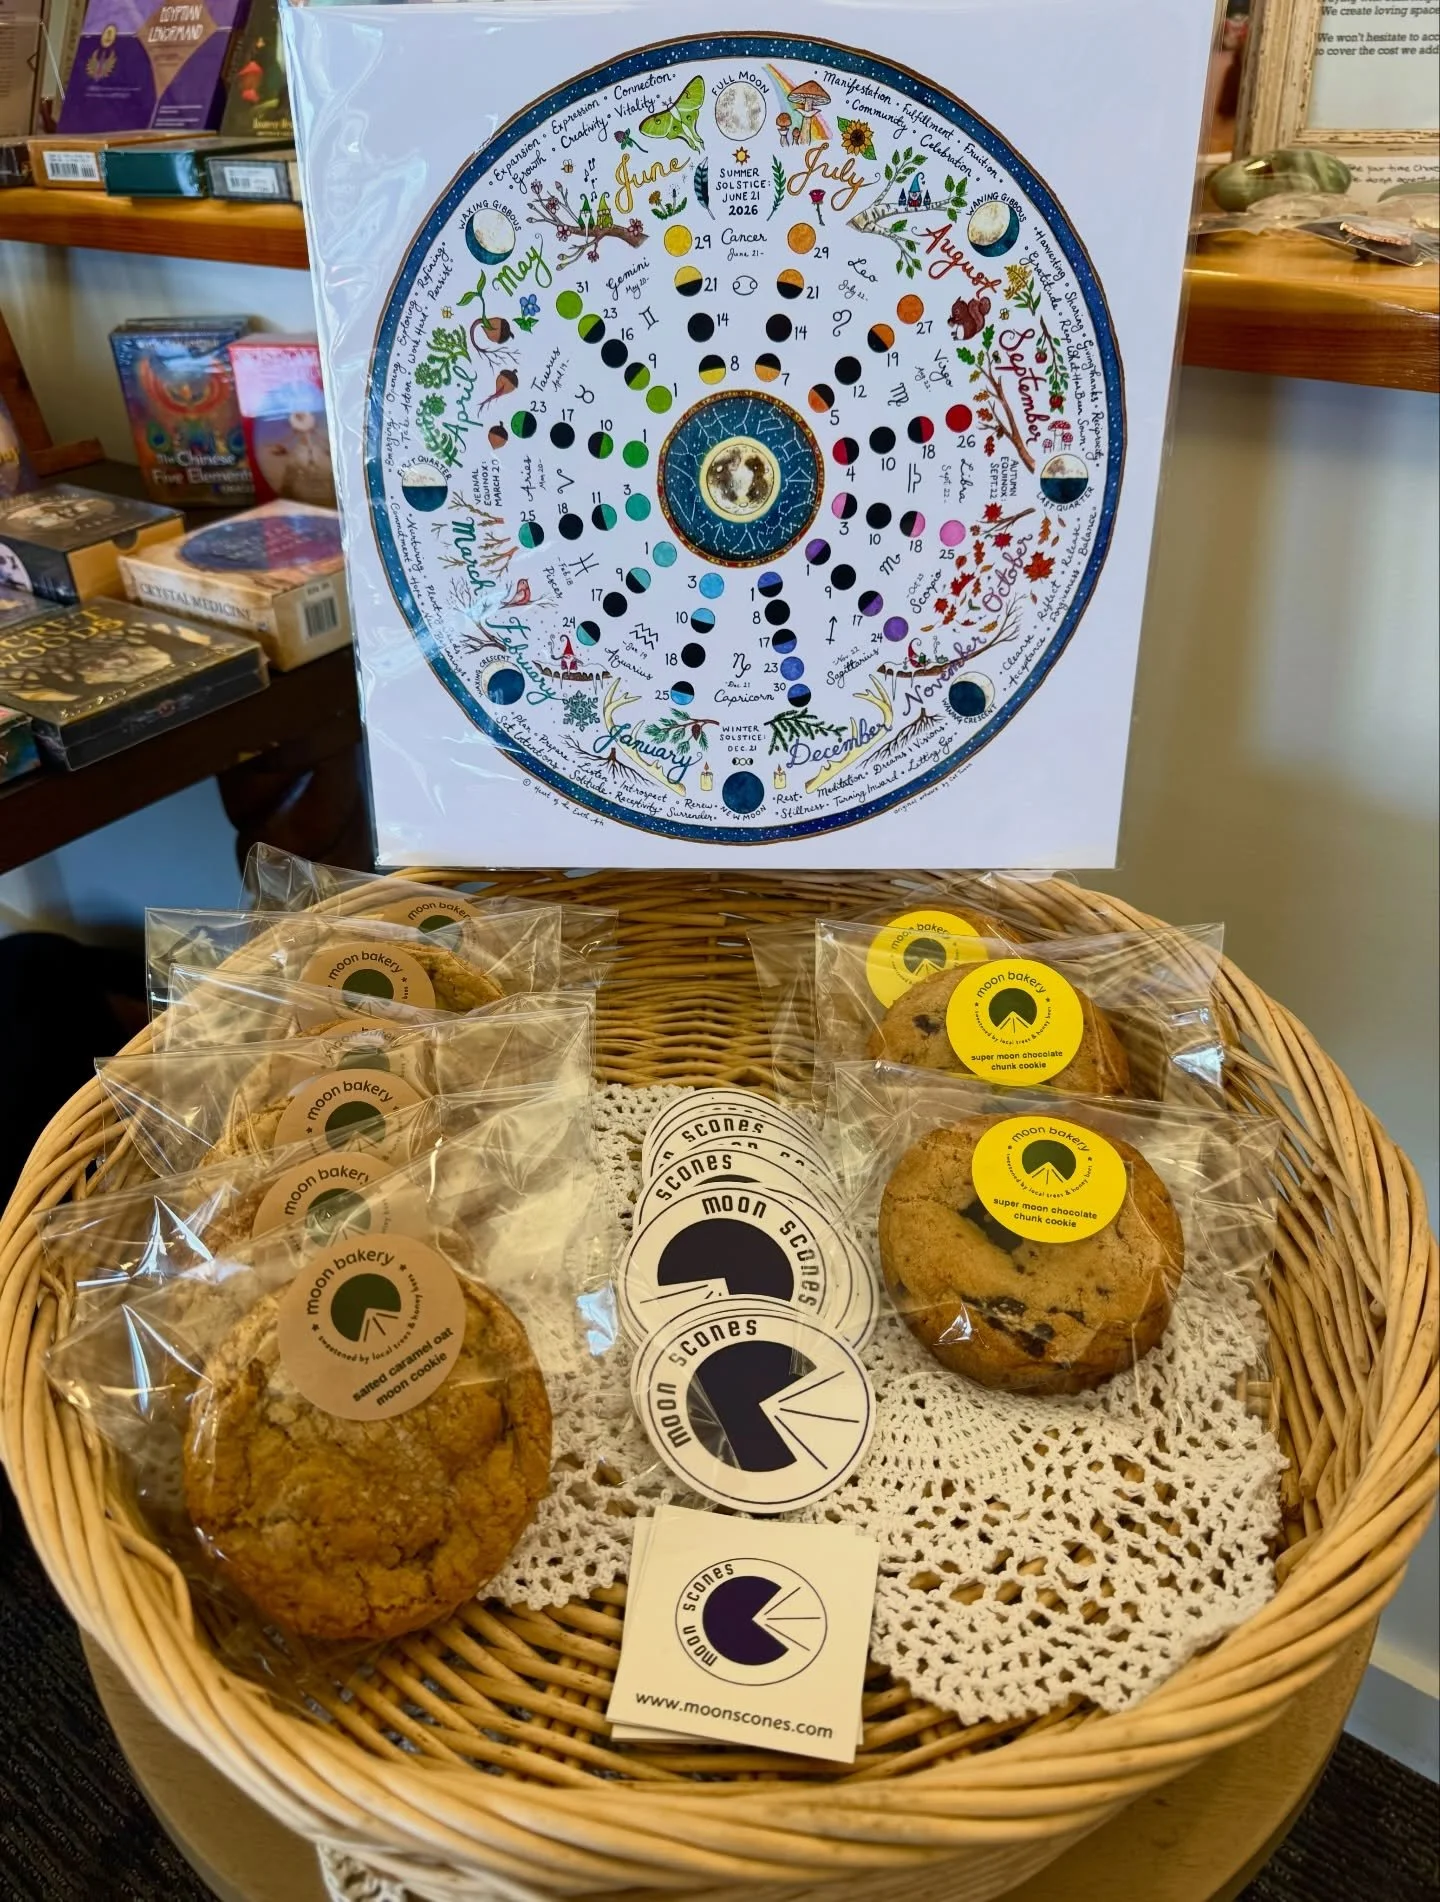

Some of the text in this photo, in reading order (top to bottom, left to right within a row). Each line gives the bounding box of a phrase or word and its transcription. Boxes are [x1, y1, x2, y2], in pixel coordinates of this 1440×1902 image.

[160, 5, 203, 22] EGYPTIAN
[1340, 7, 1373, 16] create
[1374, 6, 1408, 18] loving
[148, 24, 204, 43] LENORMAND
[1336, 32, 1364, 42] won't
[1366, 32, 1407, 42] hesitate
[1409, 33, 1420, 42] to
[1326, 45, 1417, 56] cover the cost we
[711, 70, 770, 97] FULL MOON
[493, 73, 674, 182] Expansion Expression Connection
[559, 94, 656, 149] Creativity Vitality
[822, 70, 998, 180] Manifestation Fulfillment Fruition
[851, 99, 973, 178] Community Celebration
[614, 152, 692, 215] June
[719, 167, 761, 178] SUMMER
[786, 141, 881, 213] July
[722, 192, 749, 203] JUNE
[728, 204, 759, 217] 2026
[965, 191, 1028, 224] WANING GIBBOUS
[491, 200, 522, 233] GIBBOUS
[694, 233, 712, 250] 29
[721, 227, 768, 246] Cancer
[491, 232, 553, 298] May
[813, 246, 830, 259] 29
[910, 222, 1003, 299] August
[416, 246, 447, 290] Refining
[847, 257, 878, 283] Leo
[1019, 250, 1060, 312] Gratitude
[426, 263, 455, 302] Persist
[576, 280, 589, 294] 31
[703, 276, 718, 292] 21
[806, 285, 819, 300] 21
[1035, 230, 1086, 333] Harvesting Sharing
[602, 307, 618, 319] 23
[716, 312, 730, 328] 14
[620, 327, 635, 341] 16
[794, 326, 808, 341] 14
[915, 320, 934, 335] 27
[529, 346, 562, 393] Taurus
[886, 351, 900, 368] 19
[852, 384, 868, 399] 12
[994, 327, 1051, 445] September
[441, 363, 485, 454] April
[530, 400, 548, 413] 23
[561, 408, 576, 422] 17
[599, 418, 614, 432] 10
[922, 443, 936, 460] 18
[956, 433, 977, 449] 26
[176, 450, 236, 467] Chinese
[417, 454, 453, 481] QUARTER
[880, 456, 897, 472] 10
[152, 467, 184, 486] Five
[470, 468, 480, 505] VERNAL
[493, 472, 503, 507] MARCH
[1009, 459, 1020, 497] AUTUMN
[1036, 486, 1094, 512] LAST QUARTER
[519, 510, 537, 523] 25
[450, 515, 497, 596] March
[908, 540, 923, 554] 18
[938, 548, 956, 561] 25
[981, 533, 1034, 614] October
[140, 582, 190, 602] CRYSTAL
[909, 568, 943, 615] Scorpio
[561, 615, 577, 629] 24
[479, 654, 512, 668] CRESCENT
[484, 615, 568, 706] February
[604, 647, 655, 682] Aquarius
[1001, 633, 1036, 671] Cleanse
[825, 648, 881, 690] Sagittarius
[902, 635, 988, 717] November
[713, 688, 775, 708] Capricorn
[963, 704, 999, 724] CRESCENT
[721, 724, 761, 733] WINTER
[592, 722, 703, 786] January
[727, 744, 748, 752] DEC
[785, 717, 894, 770] December
[512, 712, 714, 810] Plan Prepare Listen Introspect Renew
[776, 725, 945, 805] Rest Meditation Dreams Visions
[512, 729, 714, 821] Intentions Solitude Receptivity Surrender
[780, 769, 900, 820] Stillness Inward
[742, 803, 768, 821] MOON
[406, 902, 437, 921] moon
[328, 950, 404, 981] moon bakery
[976, 970, 1047, 999] moon bakery
[971, 1049, 1063, 1063] super moon chocolate
[991, 1060, 1047, 1071] chunk cookie
[306, 1079, 394, 1122] moon bakery
[1011, 1126, 1090, 1153] moon bakery
[284, 1174, 318, 1217] moon
[1028, 1187, 1045, 1198] local
[993, 1197, 1098, 1220] super moon chocolate
[1013, 1211, 1077, 1228] chunk cookie
[306, 1248, 396, 1317] moon bakery
[317, 1292, 424, 1365] sweetened by local honey
[352, 1326, 455, 1402] salted caramel oat
[376, 1351, 448, 1407] moon cookie
[635, 1691, 834, 1740] www.moonscones.com
